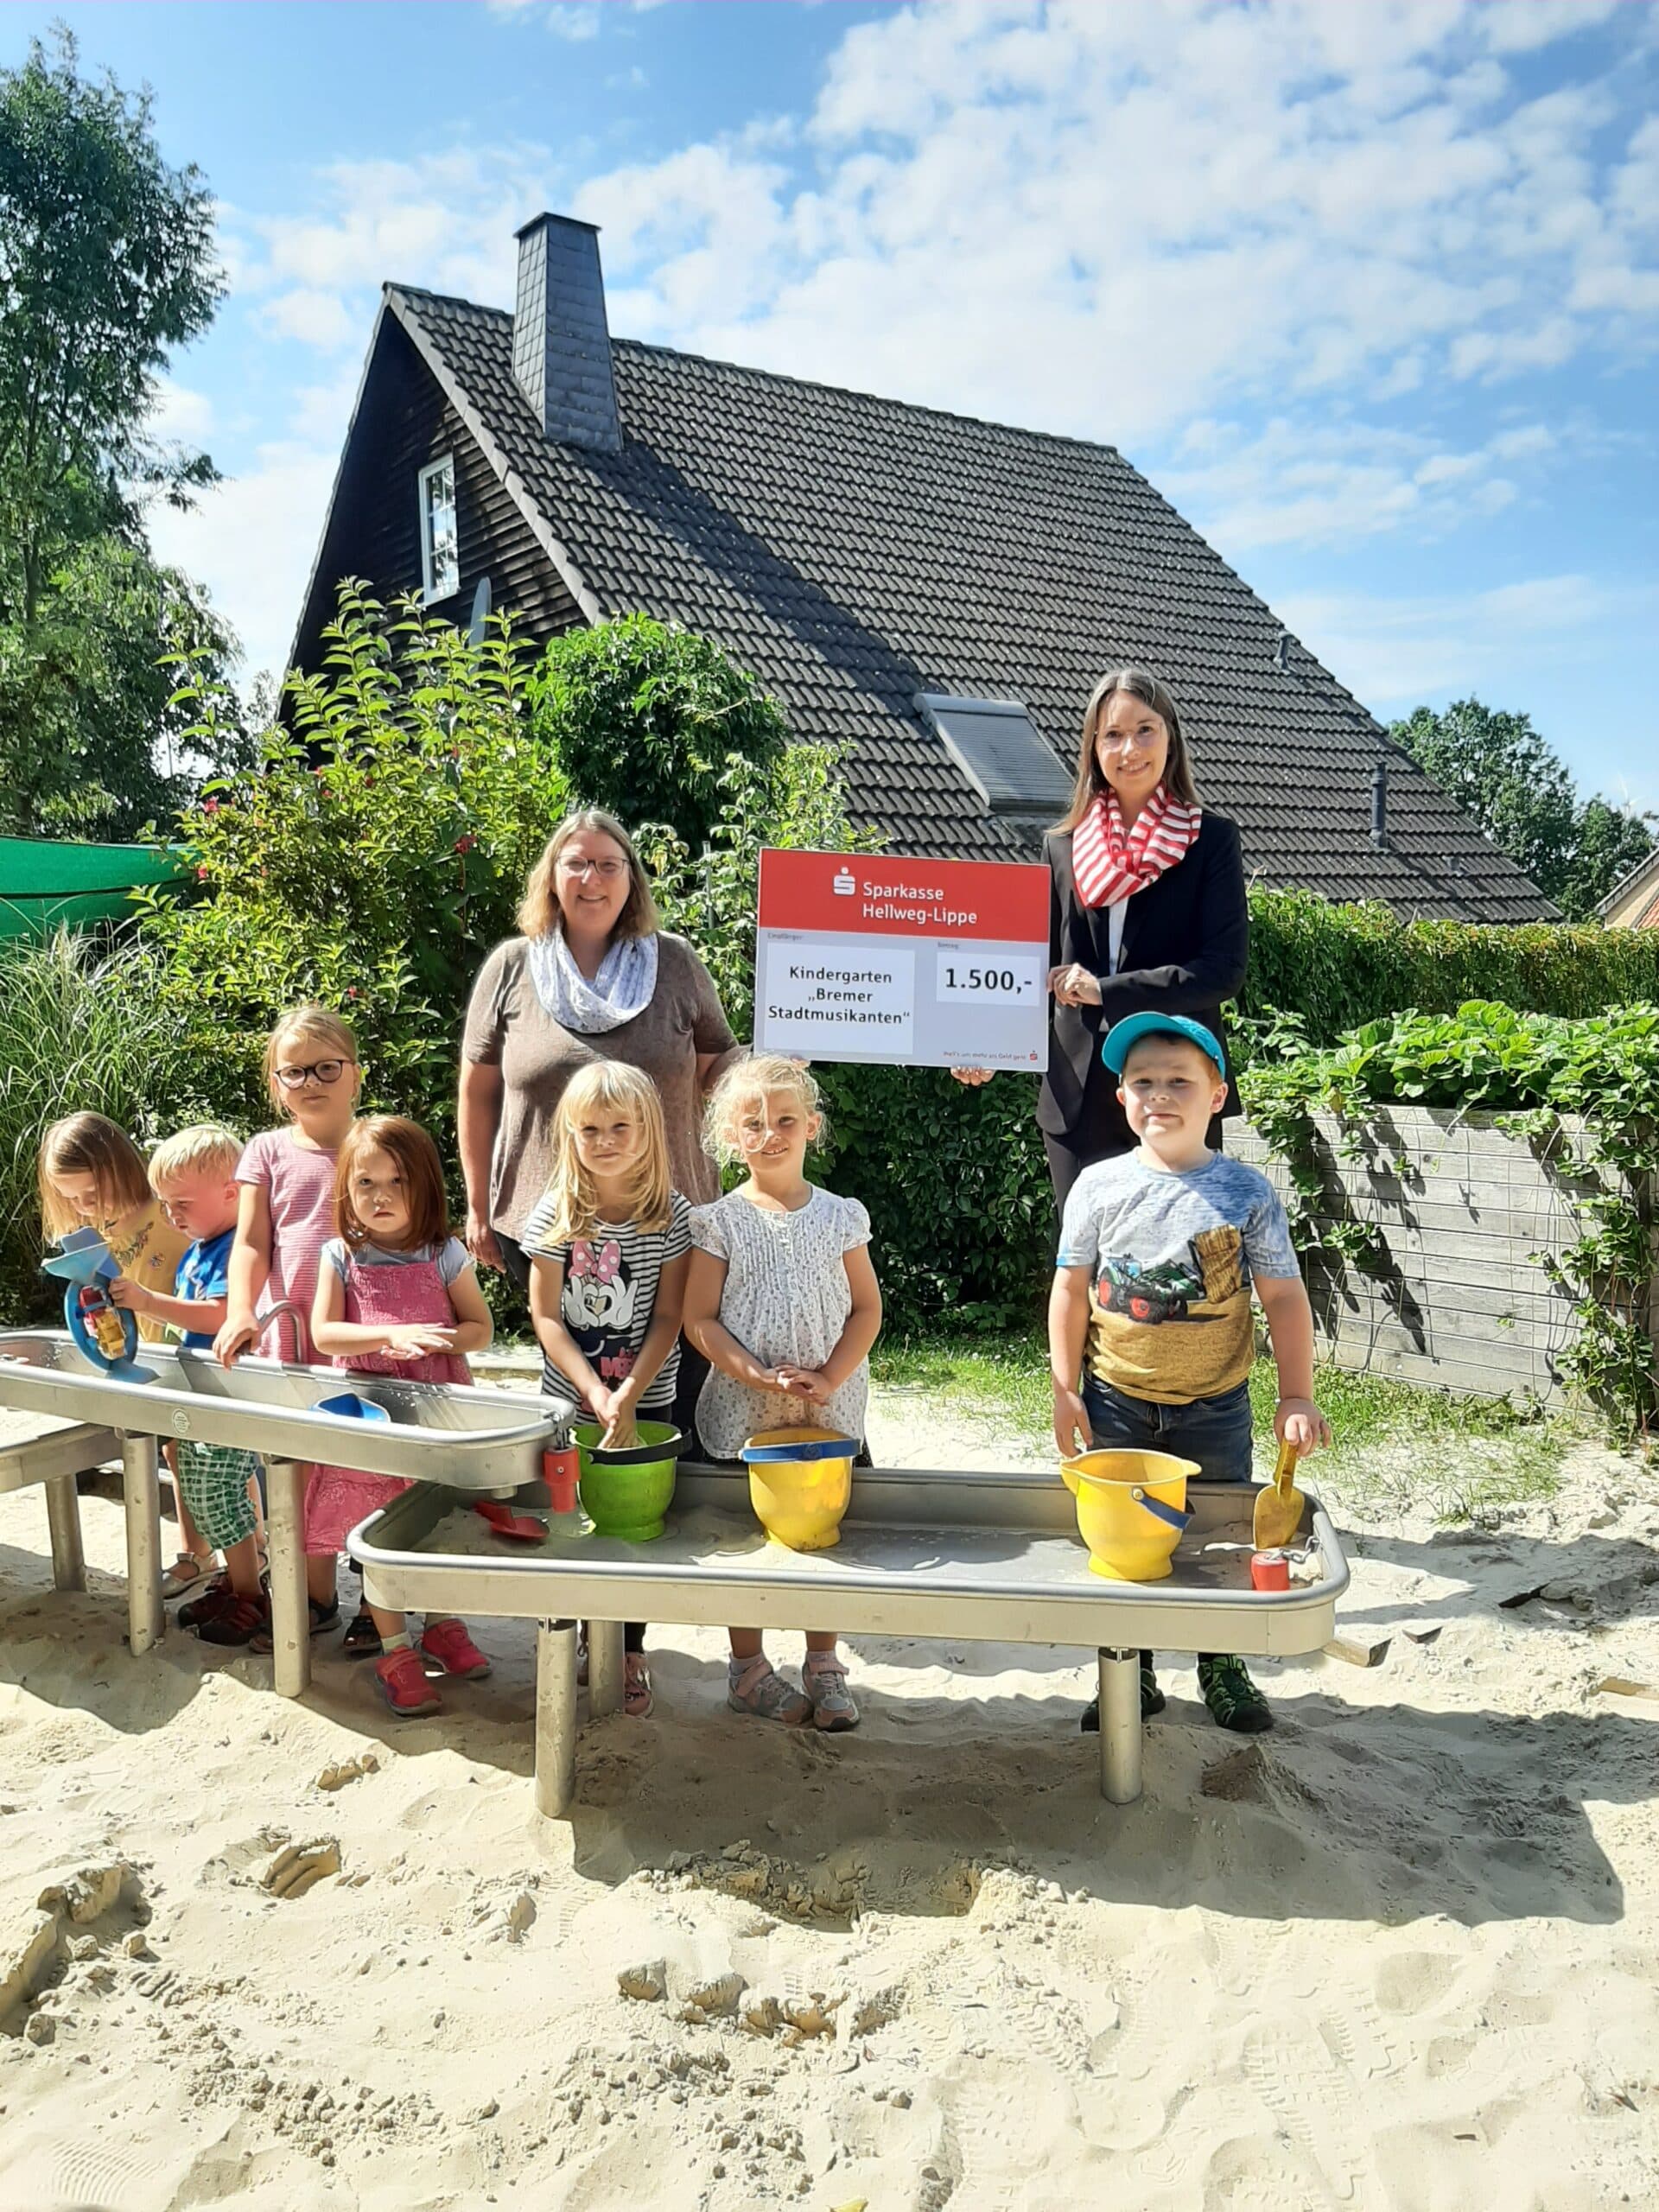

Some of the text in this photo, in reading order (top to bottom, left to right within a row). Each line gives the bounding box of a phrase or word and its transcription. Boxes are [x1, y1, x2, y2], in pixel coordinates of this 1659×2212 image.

[863, 881, 944, 900] Sparkasse
[862, 904, 978, 927] Hellweg-Lippe
[789, 965, 893, 985] Kindergarten
[945, 967, 1033, 995] 1.500,-
